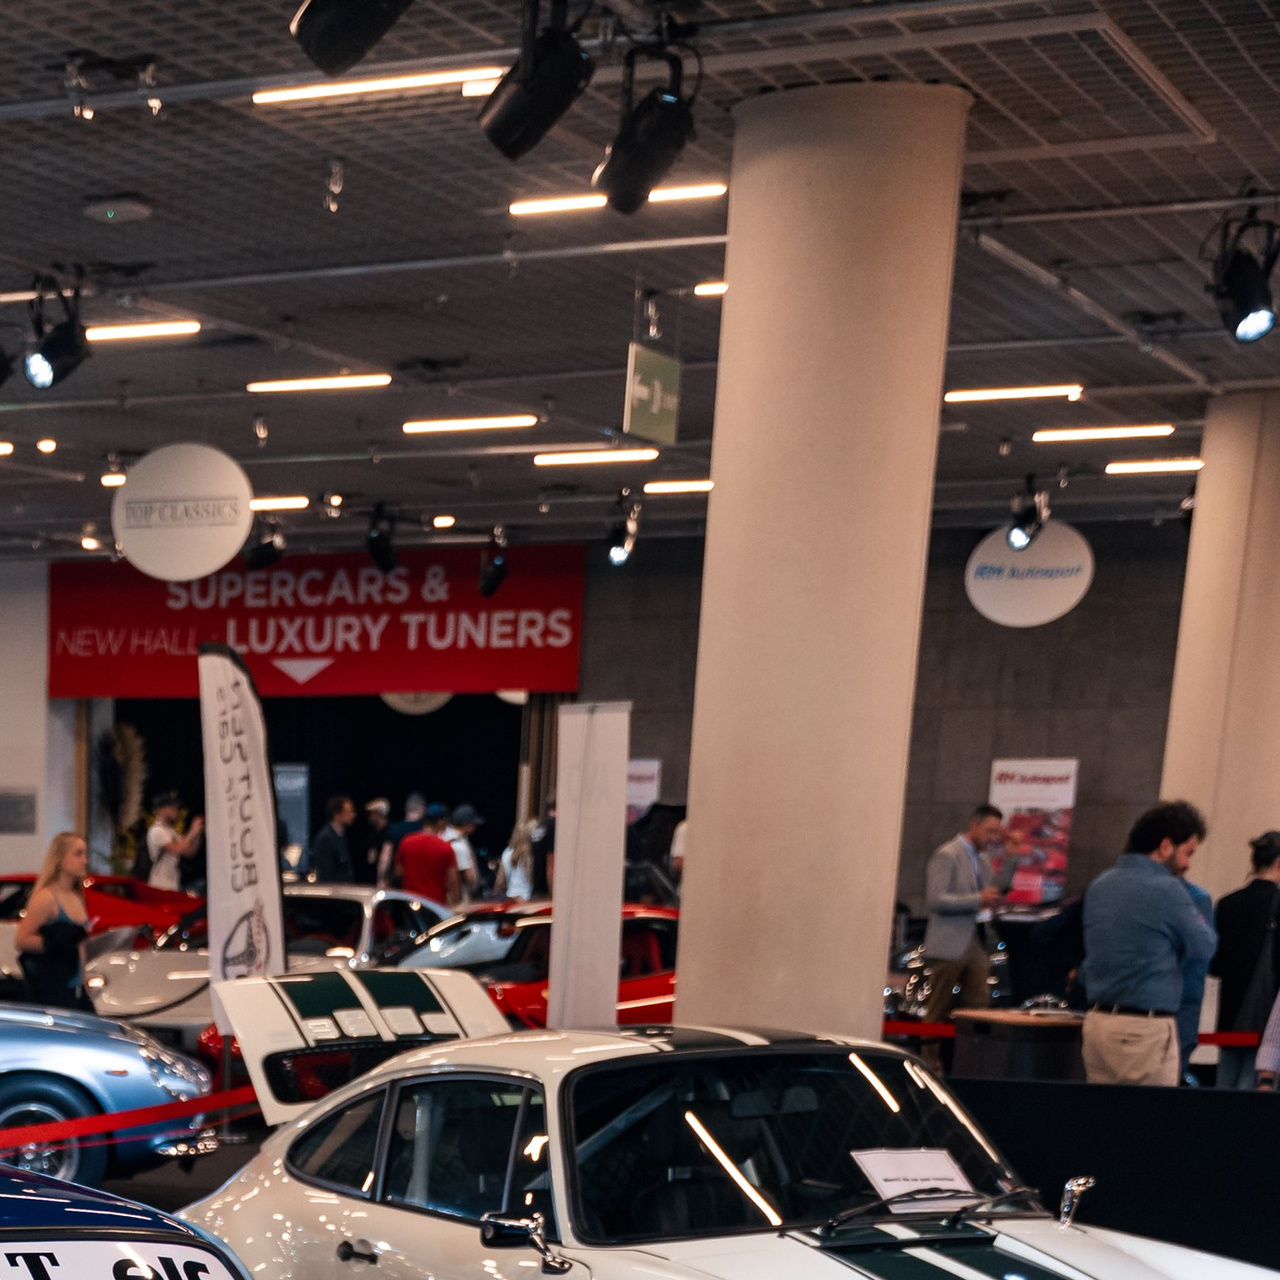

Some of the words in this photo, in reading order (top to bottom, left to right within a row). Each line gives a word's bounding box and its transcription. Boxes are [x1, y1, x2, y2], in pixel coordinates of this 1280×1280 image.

[126, 504, 153, 522] TOP
[159, 501, 238, 520] CLASSICS
[166, 569, 410, 609] SUPERCARS
[422, 564, 449, 600] &
[55, 628, 126, 656] NEW
[129, 627, 198, 655] HALL
[226, 613, 391, 653] LUXURY
[400, 609, 572, 650] TUNERS
